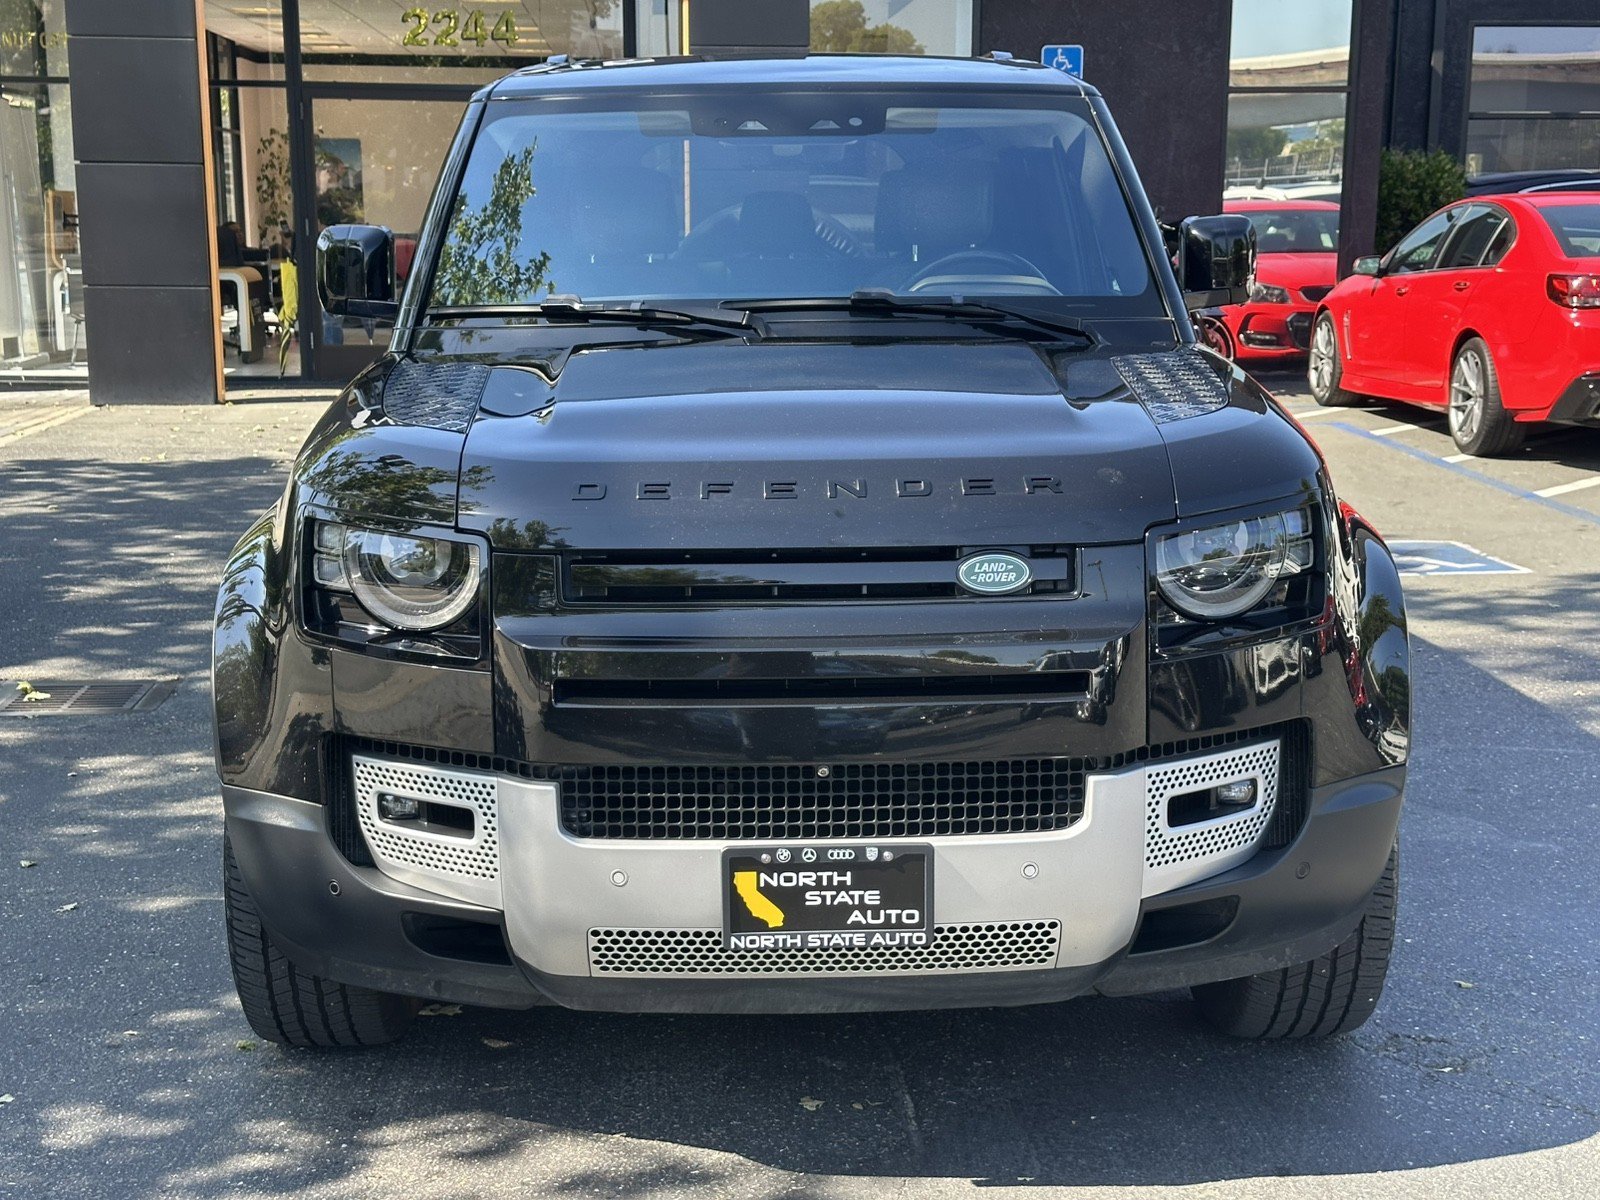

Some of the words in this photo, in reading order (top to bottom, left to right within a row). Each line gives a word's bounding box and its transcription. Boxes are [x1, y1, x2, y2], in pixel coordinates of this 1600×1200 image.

[401, 7, 519, 48] 2244
[572, 474, 1064, 501] DEFENDER
[759, 871, 852, 888] NORTH
[804, 890, 881, 906] STATE
[846, 909, 920, 925] AUTO
[730, 934, 802, 949] NORTH
[807, 933, 866, 947] STATE
[870, 932, 927, 946] AUTO
